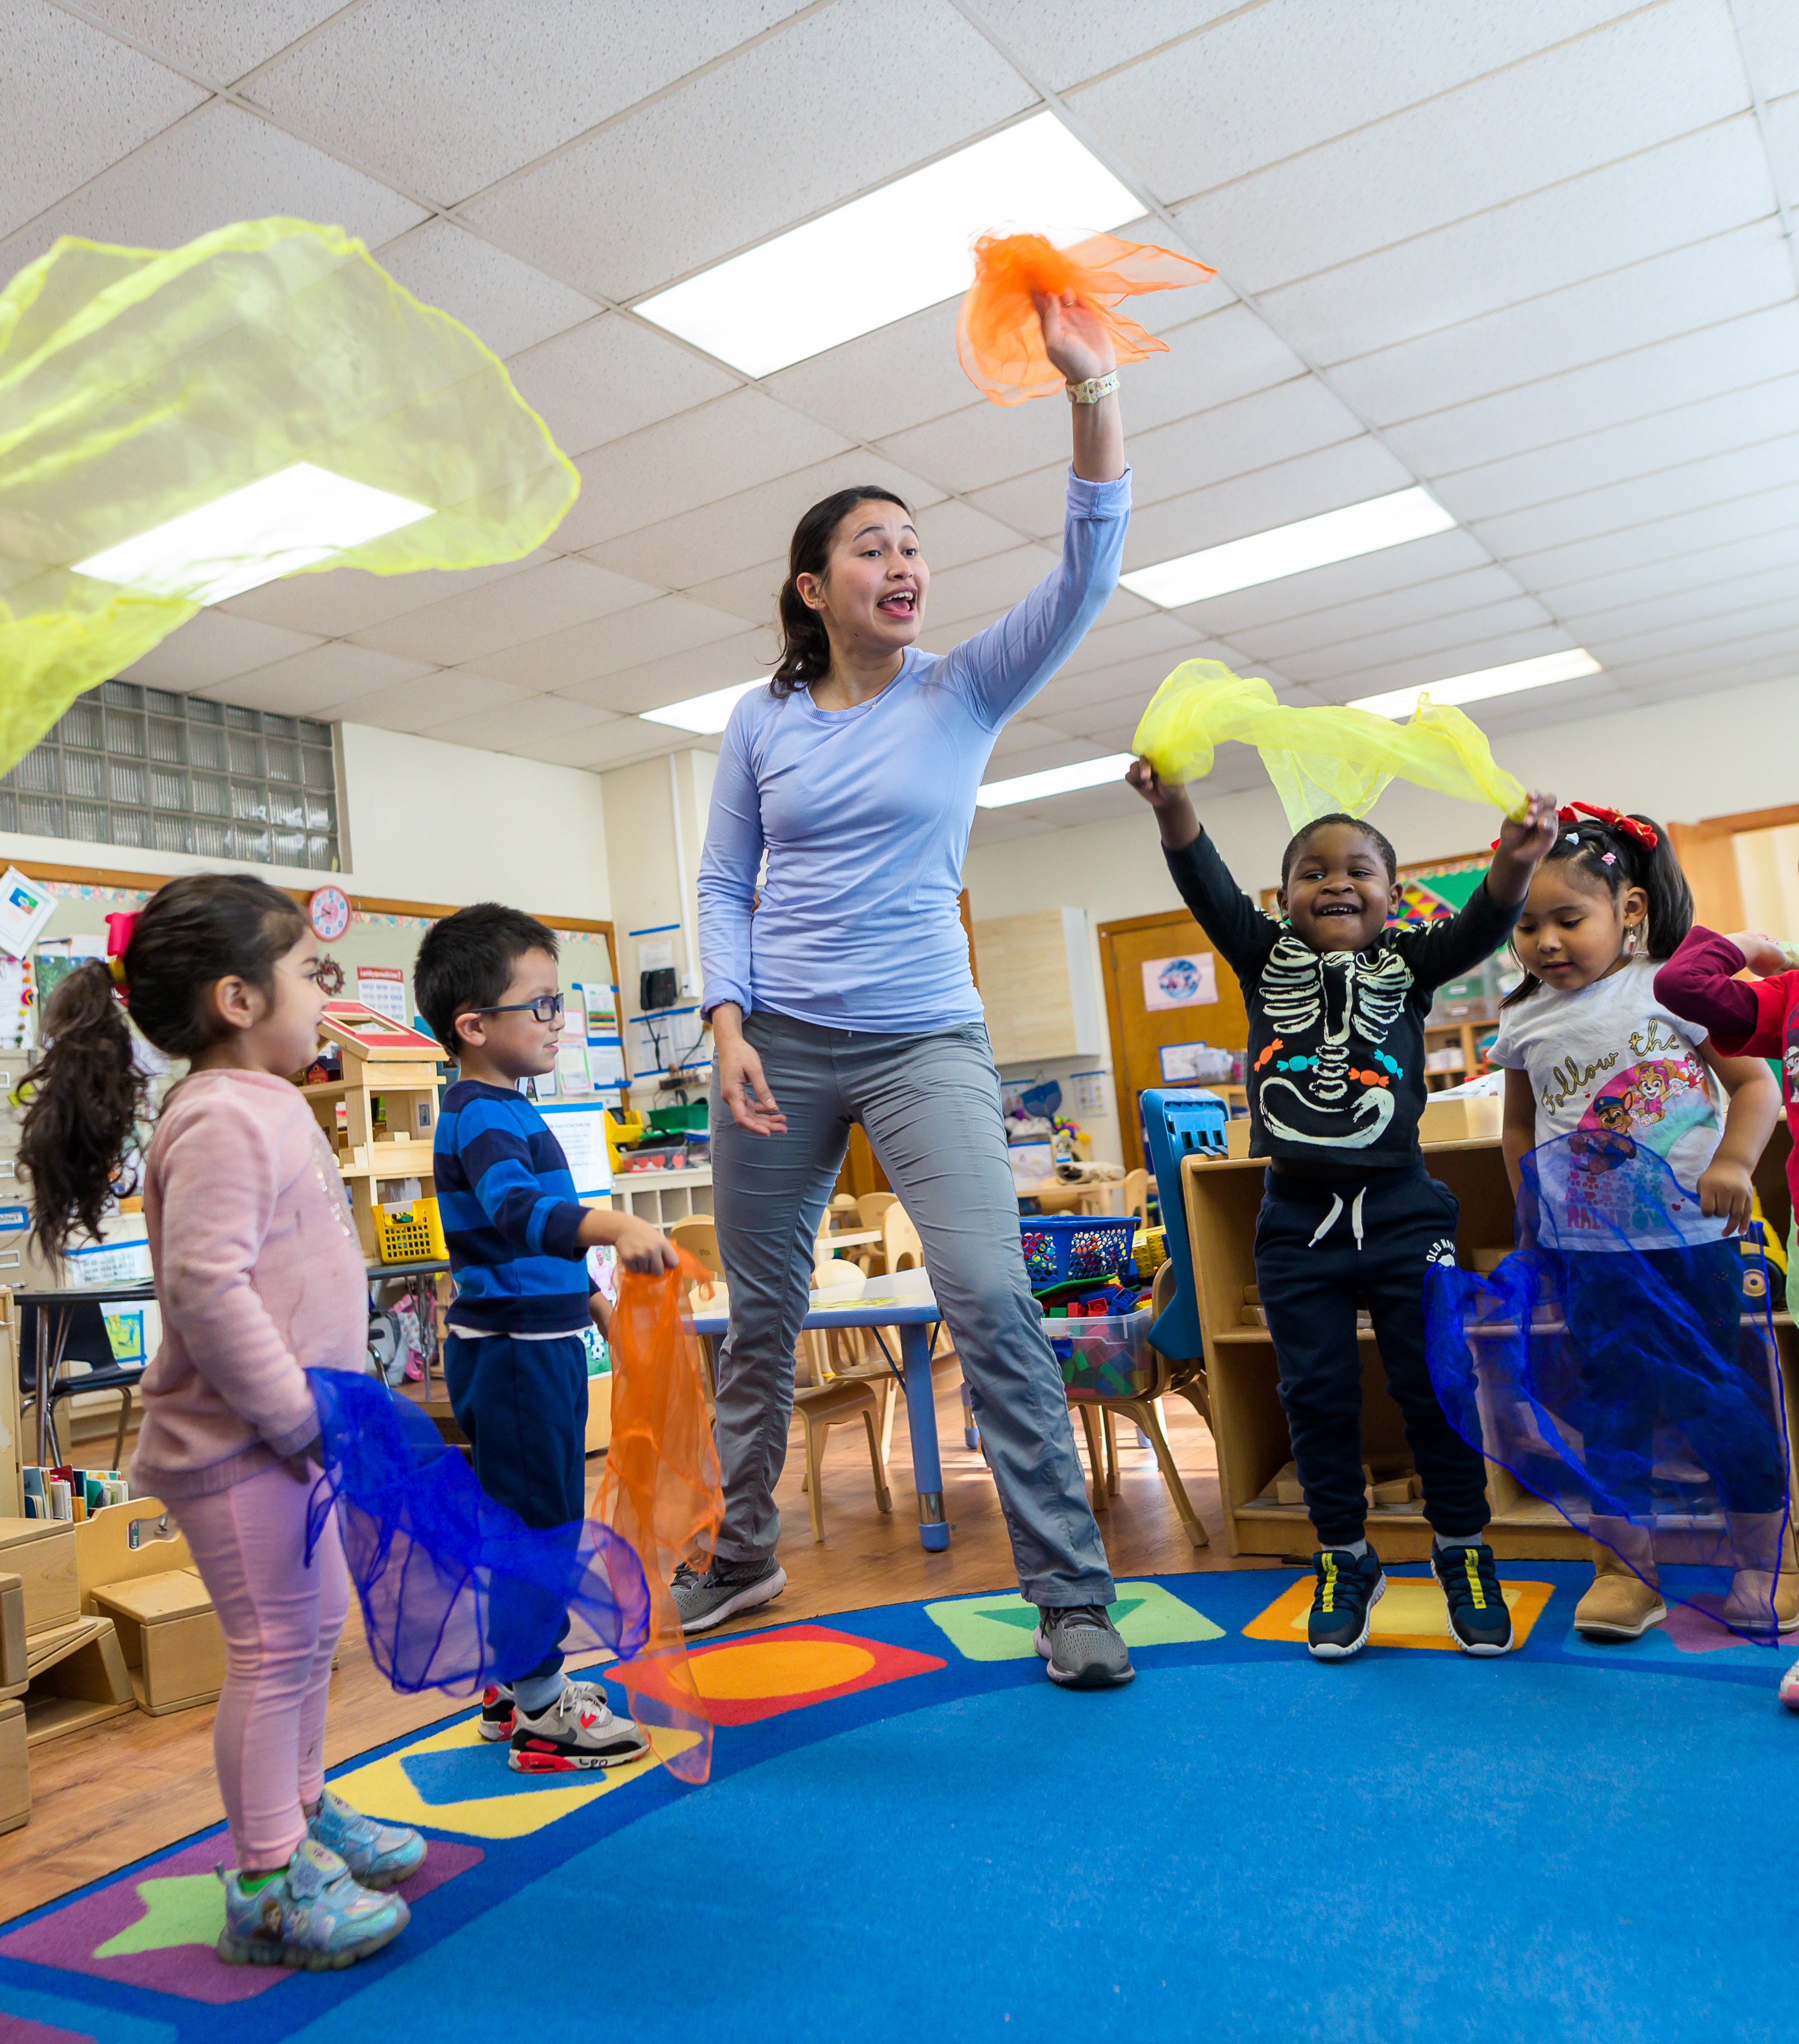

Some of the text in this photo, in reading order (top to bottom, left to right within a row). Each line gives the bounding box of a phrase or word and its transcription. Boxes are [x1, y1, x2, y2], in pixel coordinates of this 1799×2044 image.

[1541, 1019, 1680, 1116] Follow the
[1567, 1204, 1667, 1230] RAINBOW
[1426, 1242, 1442, 1263] OLD
[579, 1758, 608, 1768] Leo
